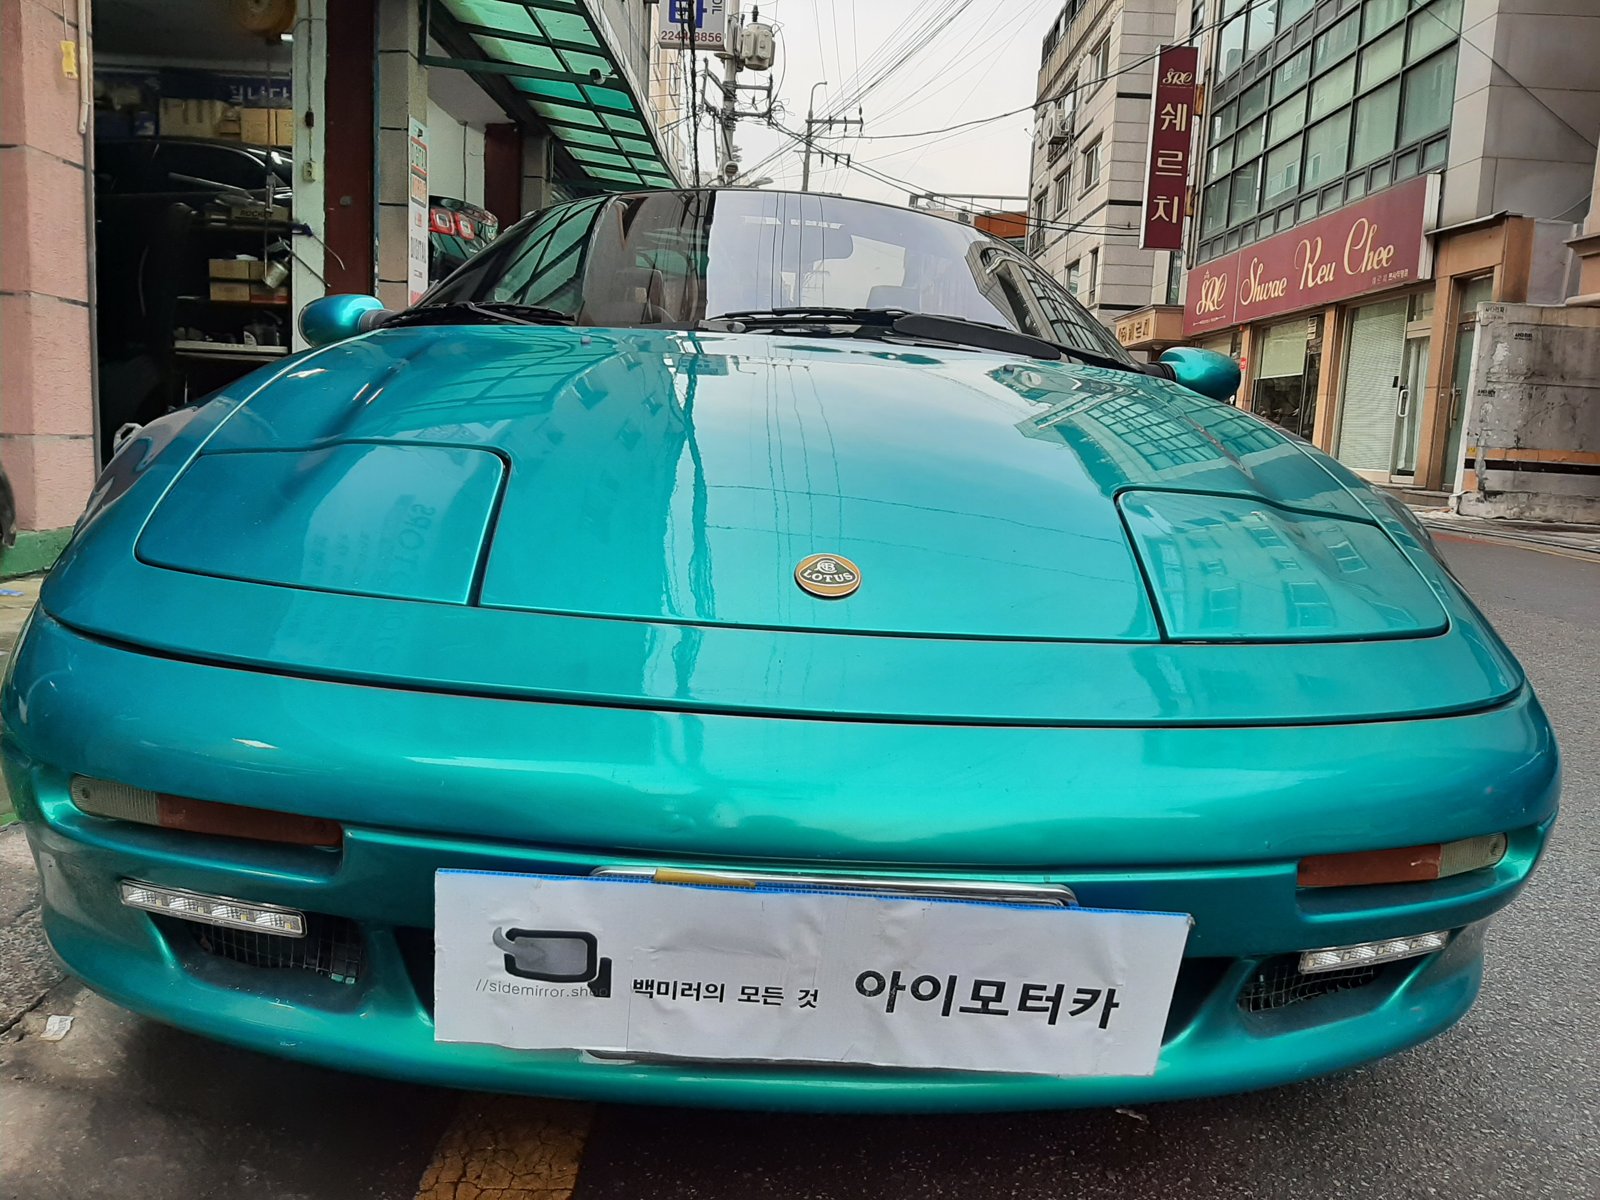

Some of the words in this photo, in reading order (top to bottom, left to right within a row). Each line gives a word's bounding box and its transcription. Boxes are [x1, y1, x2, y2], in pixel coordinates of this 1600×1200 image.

[1151, 103, 1188, 224] 쉐르치
[1240, 257, 1288, 305] Shwae
[1344, 217, 1394, 275] Chee
[803, 569, 853, 583] LOTUS
[632, 978, 726, 1003] 백미러의
[737, 985, 784, 1007] 모든
[798, 989, 819, 1008] 것
[855, 970, 1120, 1029] 아이모터카
